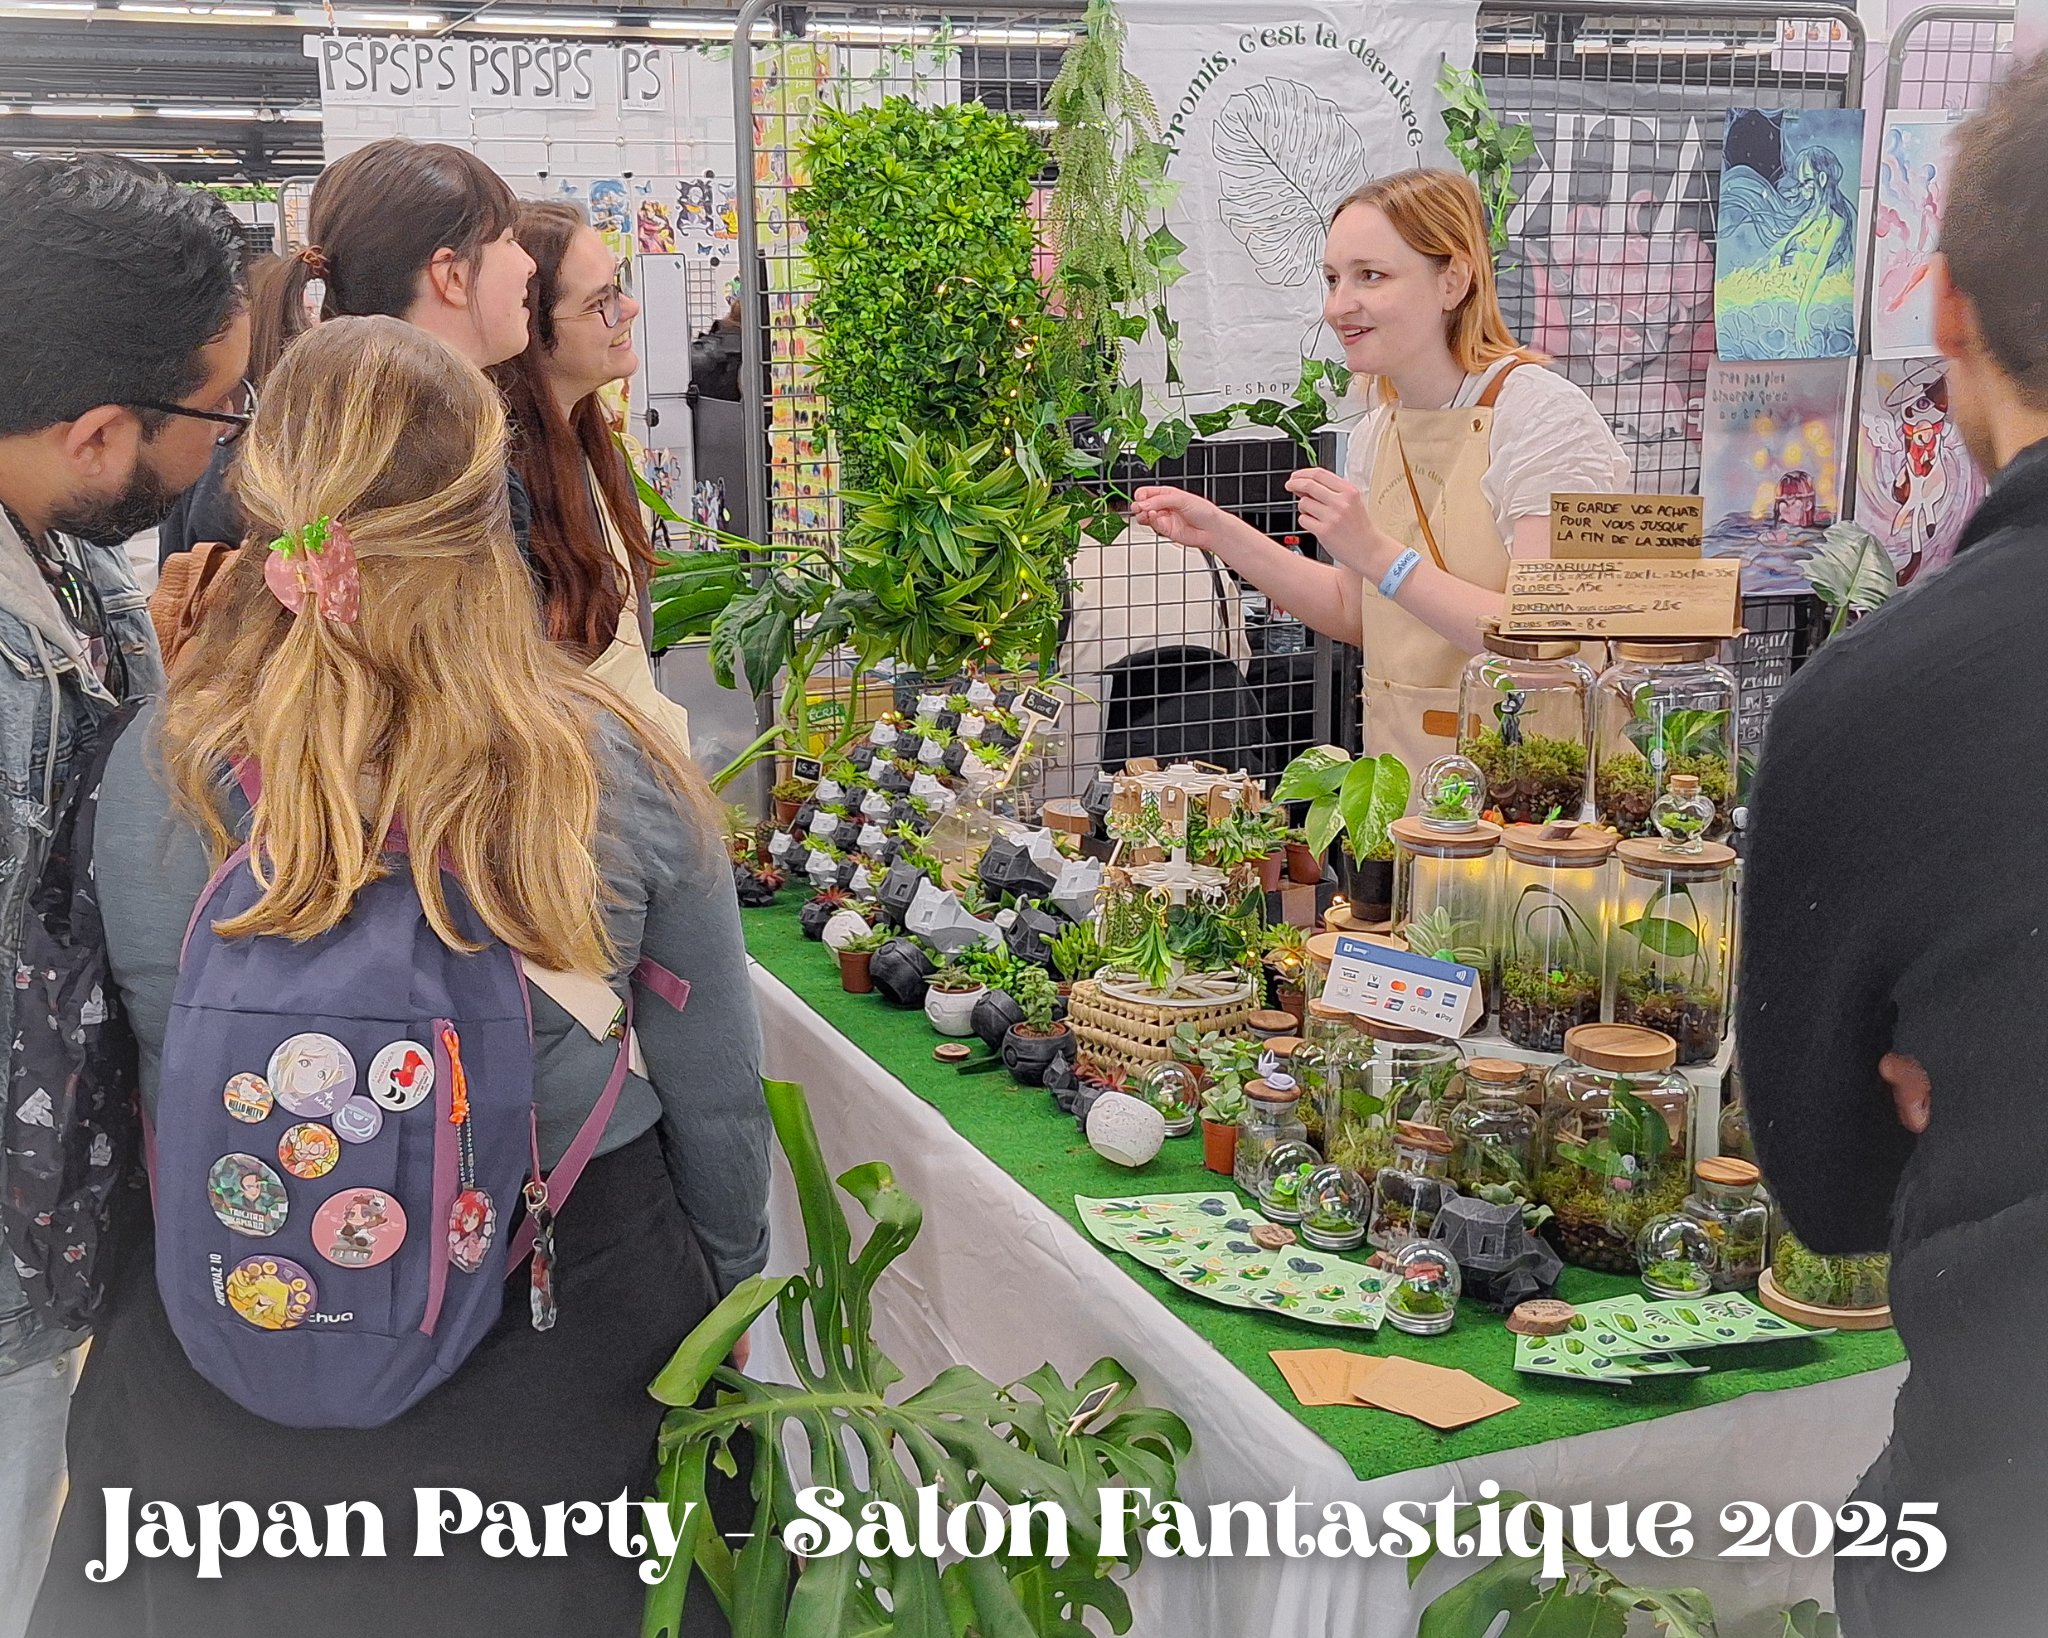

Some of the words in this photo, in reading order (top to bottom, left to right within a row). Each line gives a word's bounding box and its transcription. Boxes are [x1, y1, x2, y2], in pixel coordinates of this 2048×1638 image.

[622, 48, 662, 101] PS
[1315, 22, 1339, 49] la
[1348, 38, 1424, 147] dernière
[1551, 500, 1570, 512] JE
[1577, 501, 1622, 514] GARDE
[1657, 505, 1699, 518] ACHATS
[1560, 515, 1592, 528] POUR
[1602, 519, 1635, 531] VOUS
[1557, 530, 1574, 541] LA
[1581, 532, 1606, 543] FIN
[1611, 535, 1629, 545] DE
[1635, 537, 1652, 546] LA
[1511, 583, 1565, 593] GLOBES
[1343, 971, 1357, 979] VISA
[228, 1098, 247, 1113] HELLO
[246, 1104, 265, 1119] KITTY
